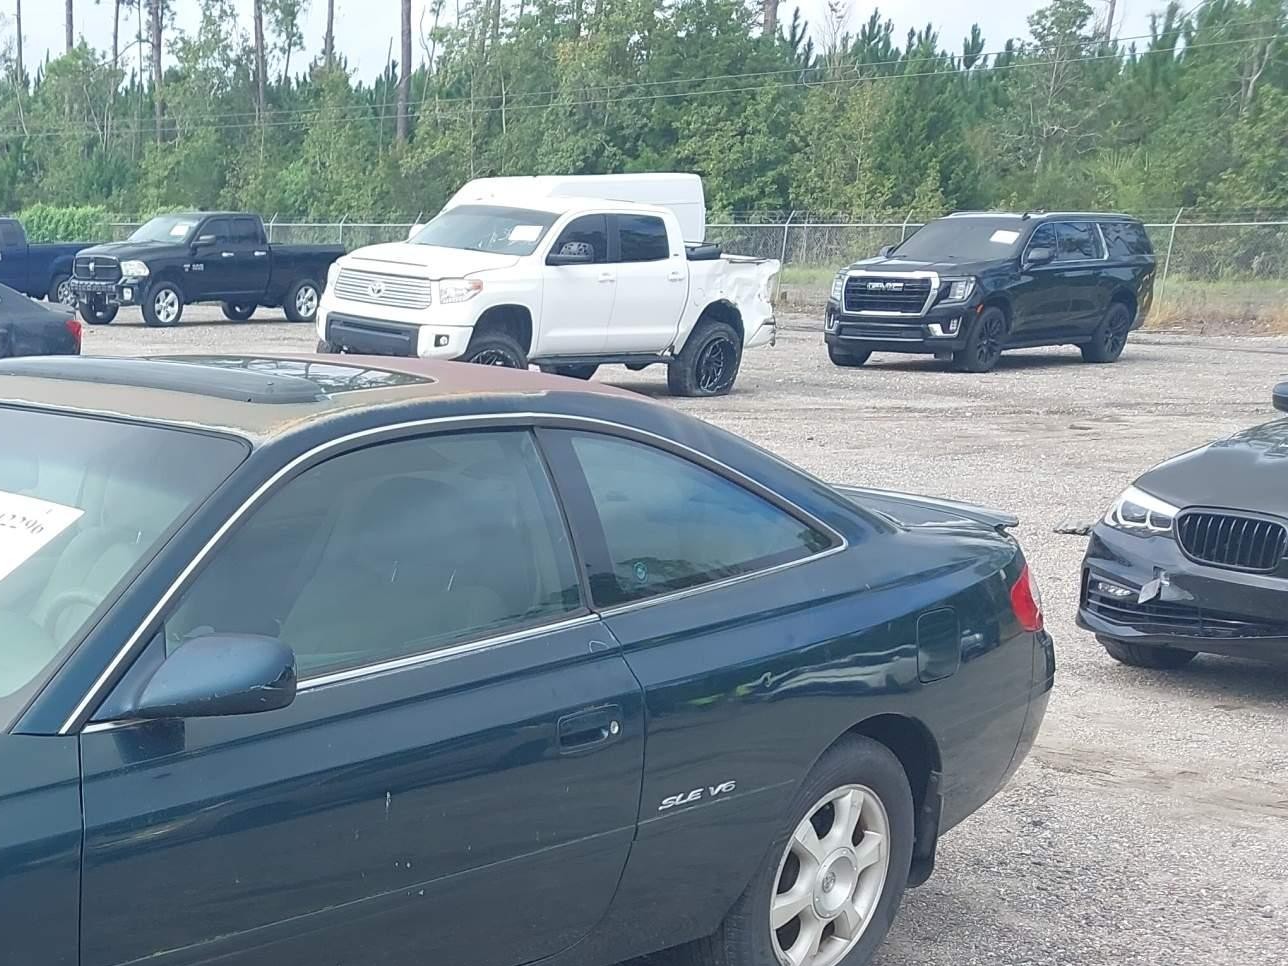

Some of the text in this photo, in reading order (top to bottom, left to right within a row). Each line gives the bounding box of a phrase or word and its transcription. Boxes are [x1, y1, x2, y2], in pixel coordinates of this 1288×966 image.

[867, 282, 904, 291] GMC
[658, 780, 736, 811] SLE V6
